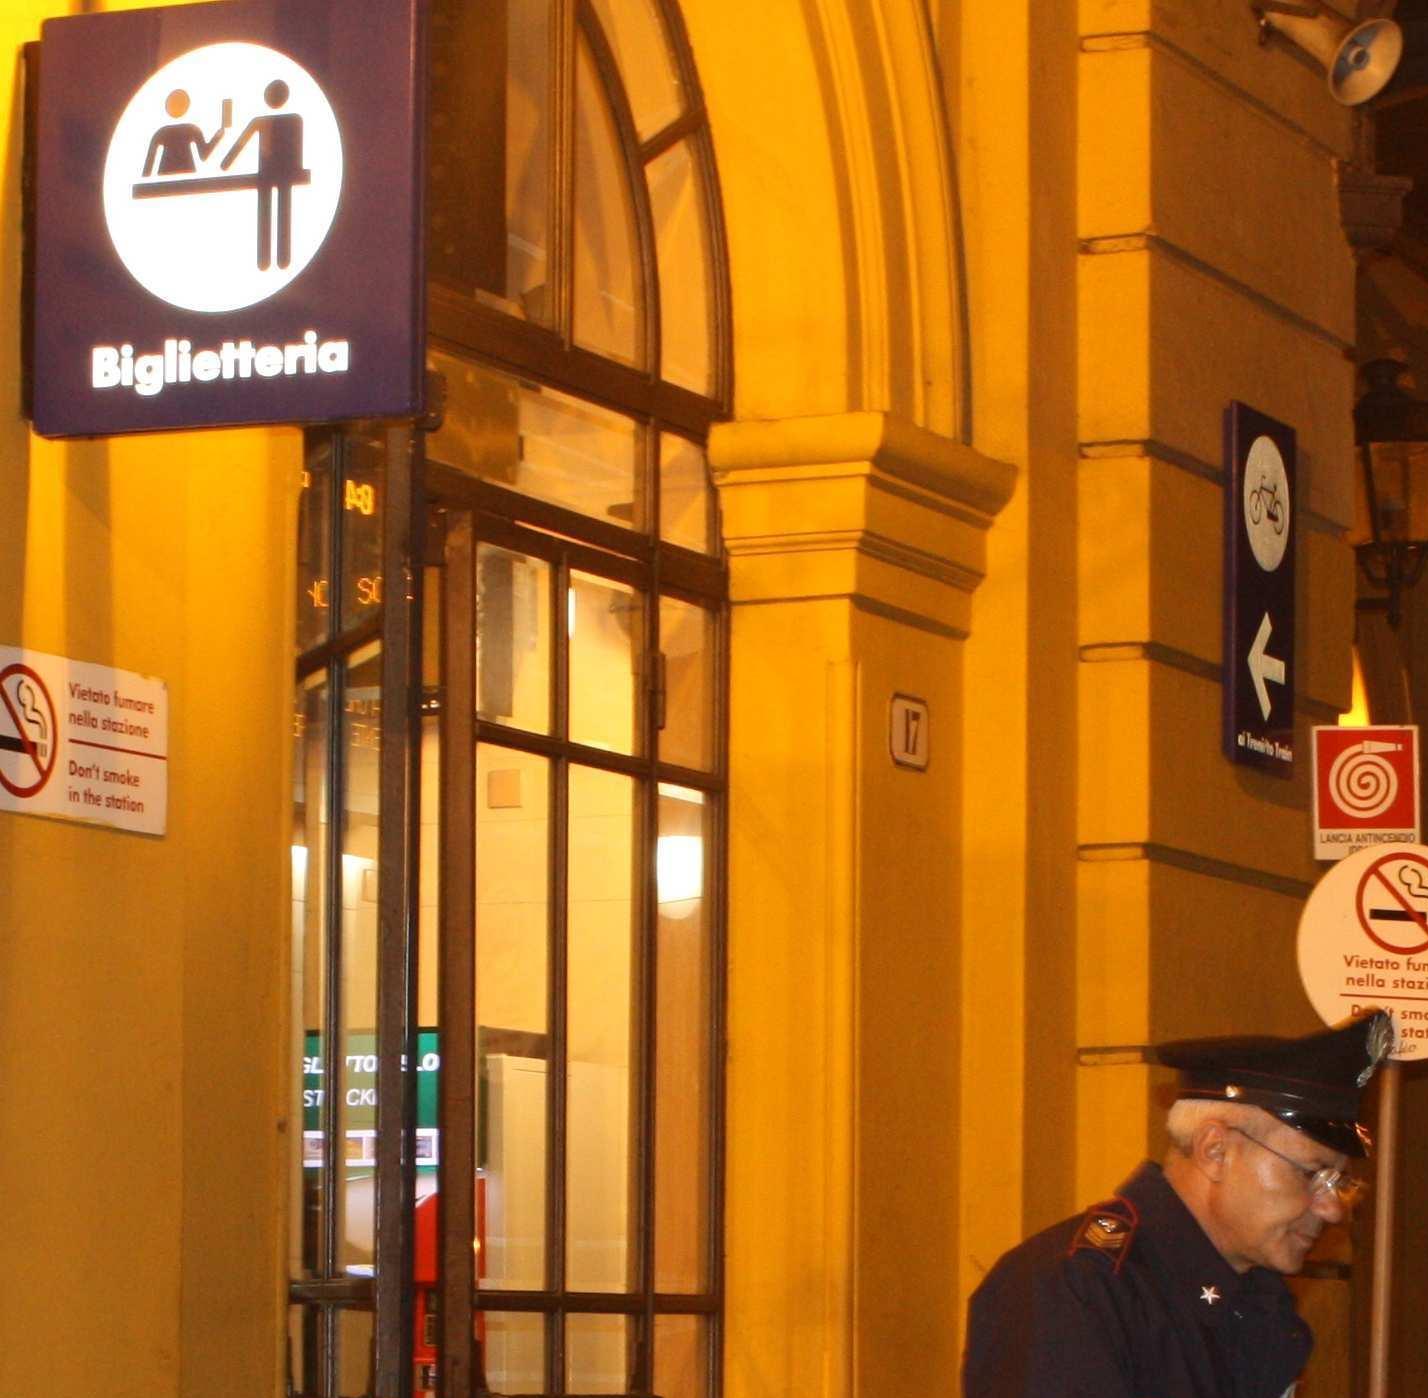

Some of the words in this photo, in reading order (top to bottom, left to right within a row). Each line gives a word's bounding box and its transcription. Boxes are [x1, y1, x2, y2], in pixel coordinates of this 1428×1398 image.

[91, 330, 349, 396] Biglietteria
[68, 681, 111, 705] Vietato
[113, 690, 155, 714] fumare
[68, 710, 98, 729] nella
[101, 718, 149, 738] stazione
[68, 760, 100, 780] Don't
[103, 769, 140, 787] smoke
[68, 786, 80, 802] in
[83, 788, 102, 806] the
[105, 795, 145, 813] station
[1320, 832, 1354, 844] LANCIA
[1343, 954, 1400, 970] Vietato
[1345, 974, 1386, 988] nella
